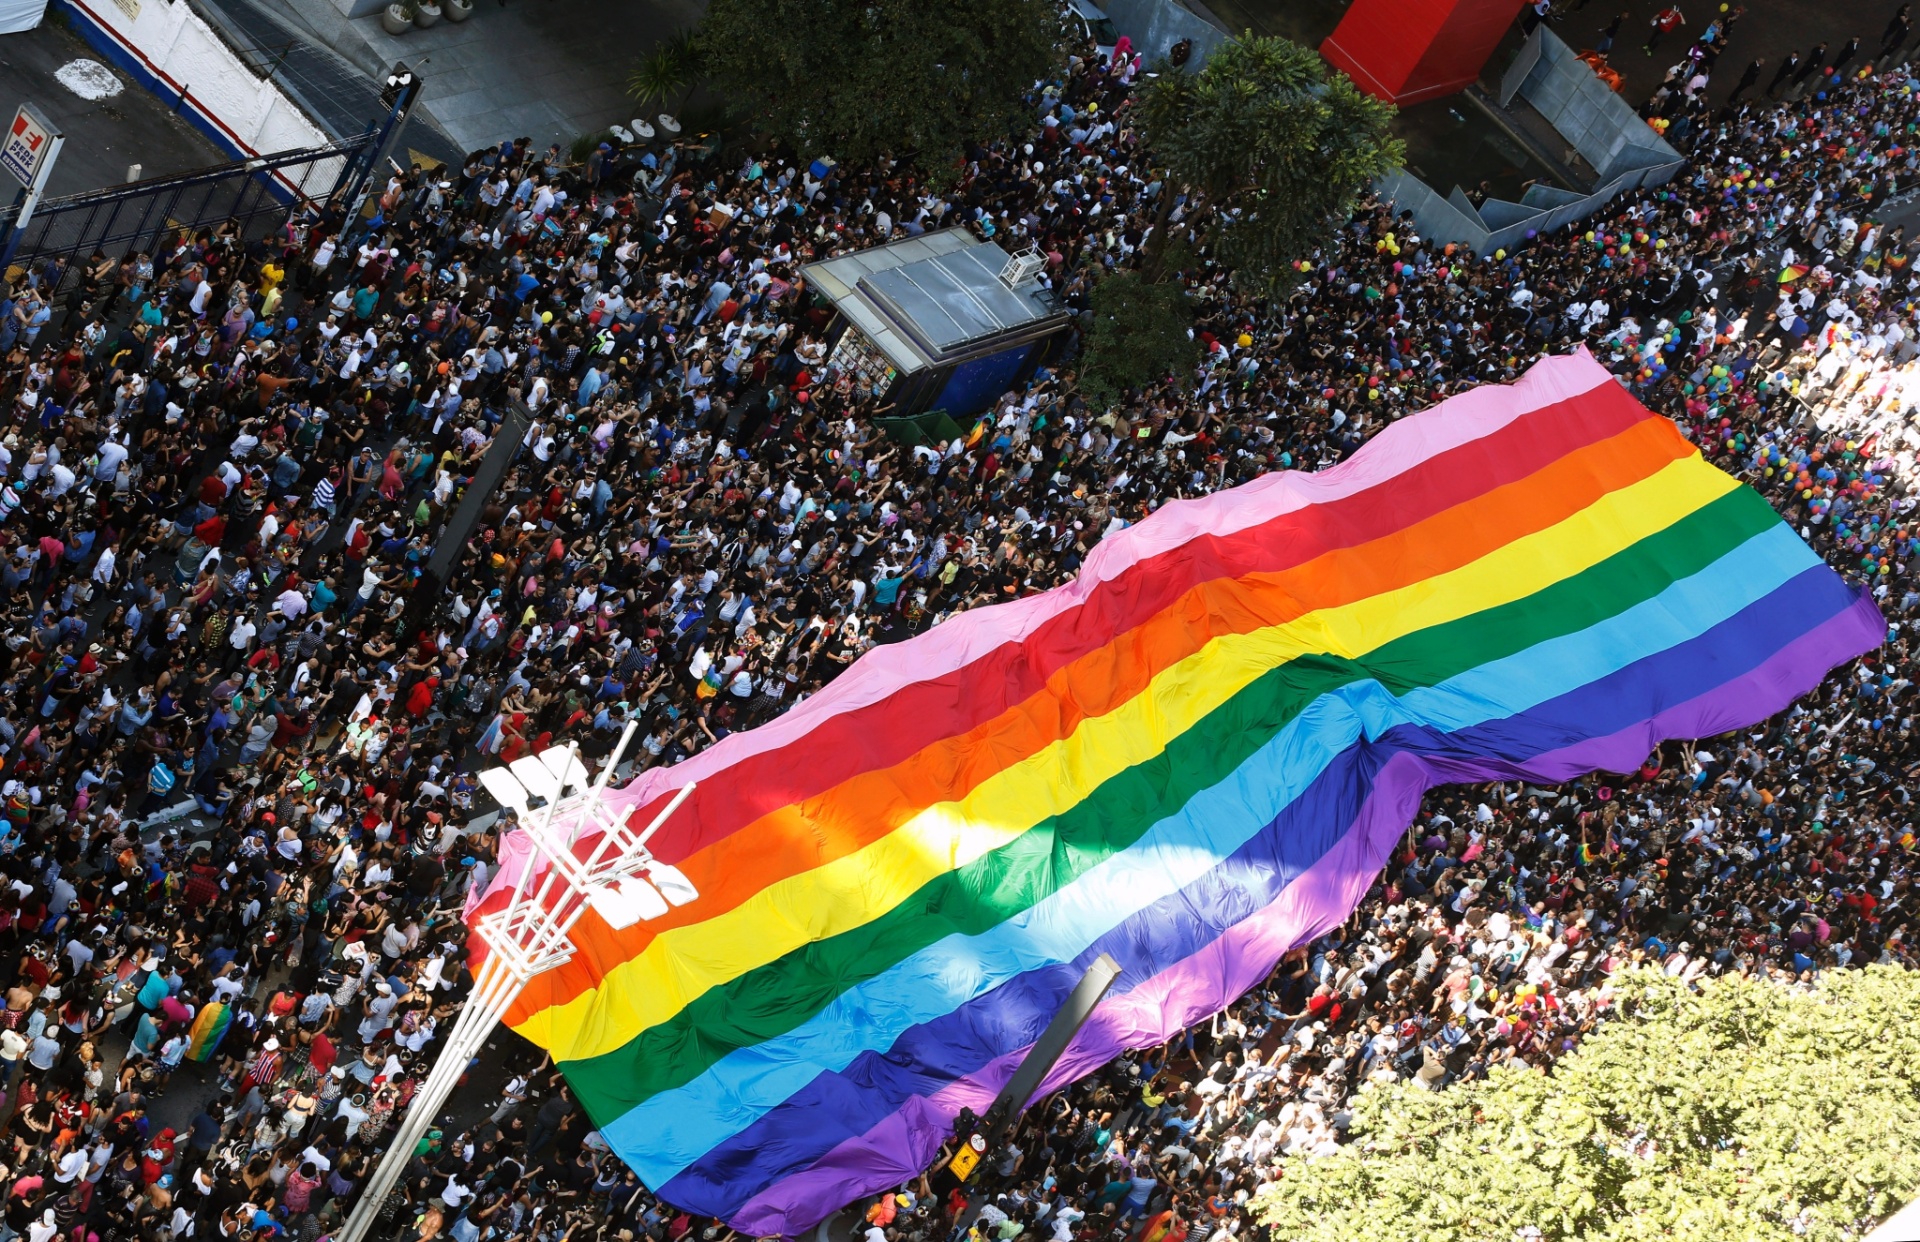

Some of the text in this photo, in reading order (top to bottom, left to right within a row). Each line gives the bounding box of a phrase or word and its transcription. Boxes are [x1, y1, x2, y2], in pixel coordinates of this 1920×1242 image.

[9, 145, 33, 168] PARK
[13, 140, 36, 163] REDE
[2, 155, 30, 183] ESTACIONE
